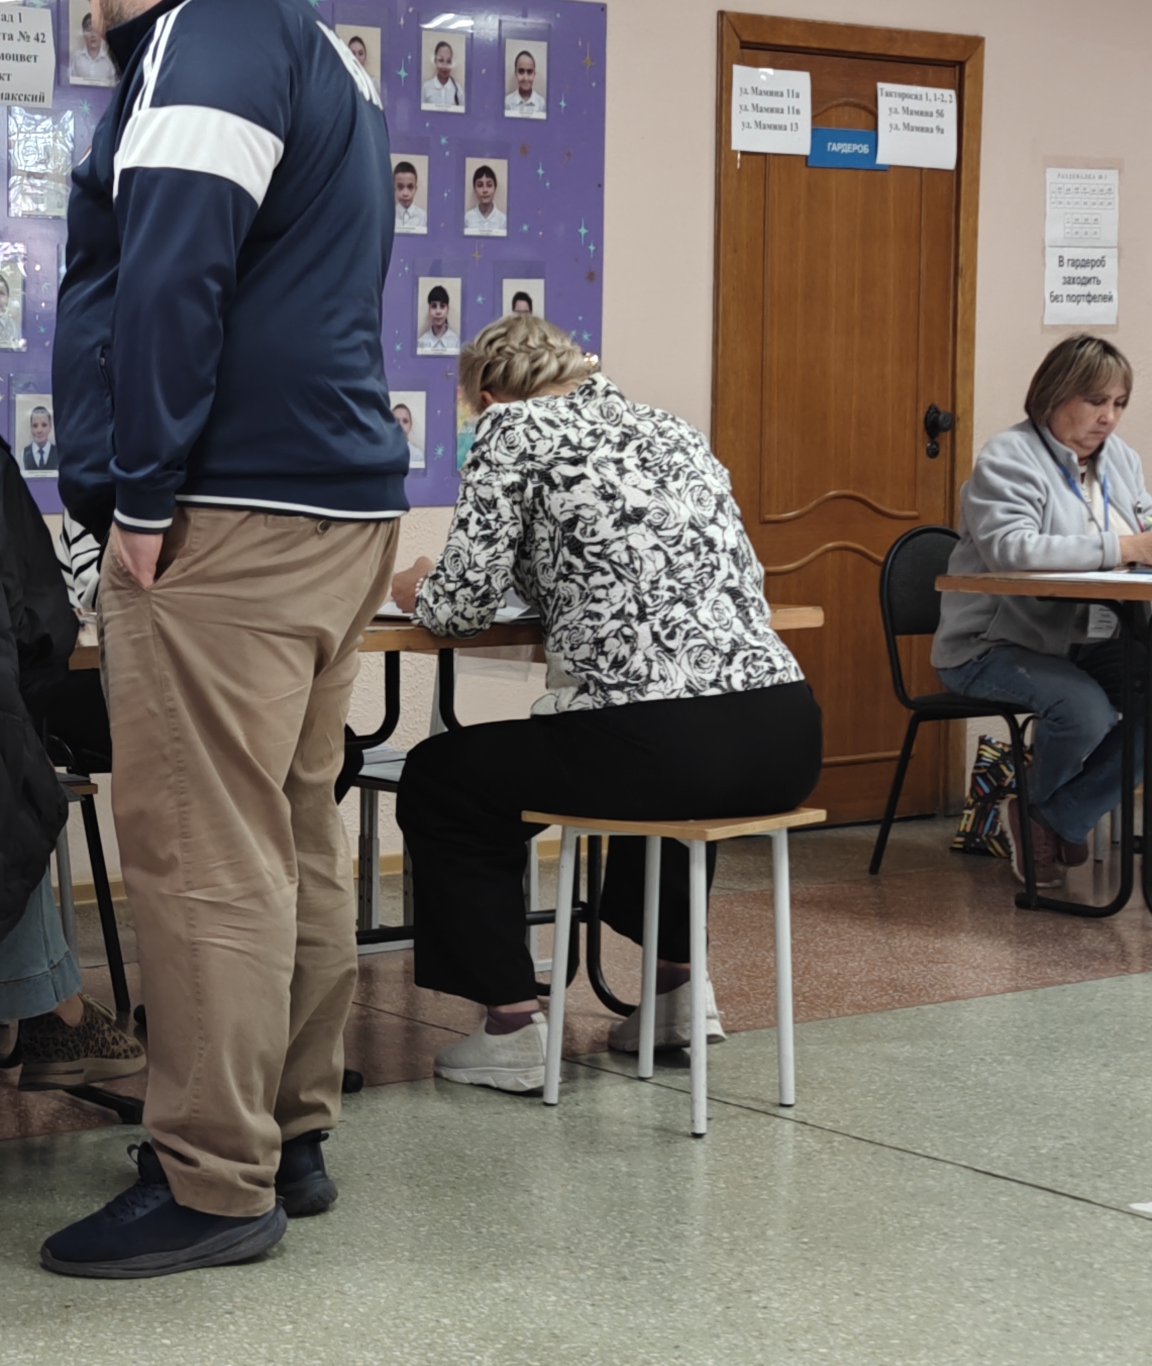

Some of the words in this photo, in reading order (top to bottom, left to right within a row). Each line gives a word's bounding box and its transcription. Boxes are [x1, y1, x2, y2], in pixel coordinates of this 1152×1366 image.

[17, 12, 23, 23] 1
[17, 30, 31, 43] №
[33, 31, 46, 44] 42
[751, 86, 784, 98] Мамина
[751, 103, 784, 114] Мамина
[901, 106, 933, 118] Мамина
[754, 120, 787, 132] Мамина
[790, 122, 799, 132] 13
[902, 122, 934, 134] Мамина
[827, 142, 869, 154] ГАРДЕРОБ
[1058, 256, 1064, 267] В
[1067, 256, 1106, 270] гардероб
[1062, 276, 1102, 286] заходить
[1049, 291, 1064, 303] без
[1066, 291, 1114, 305] портфелей
